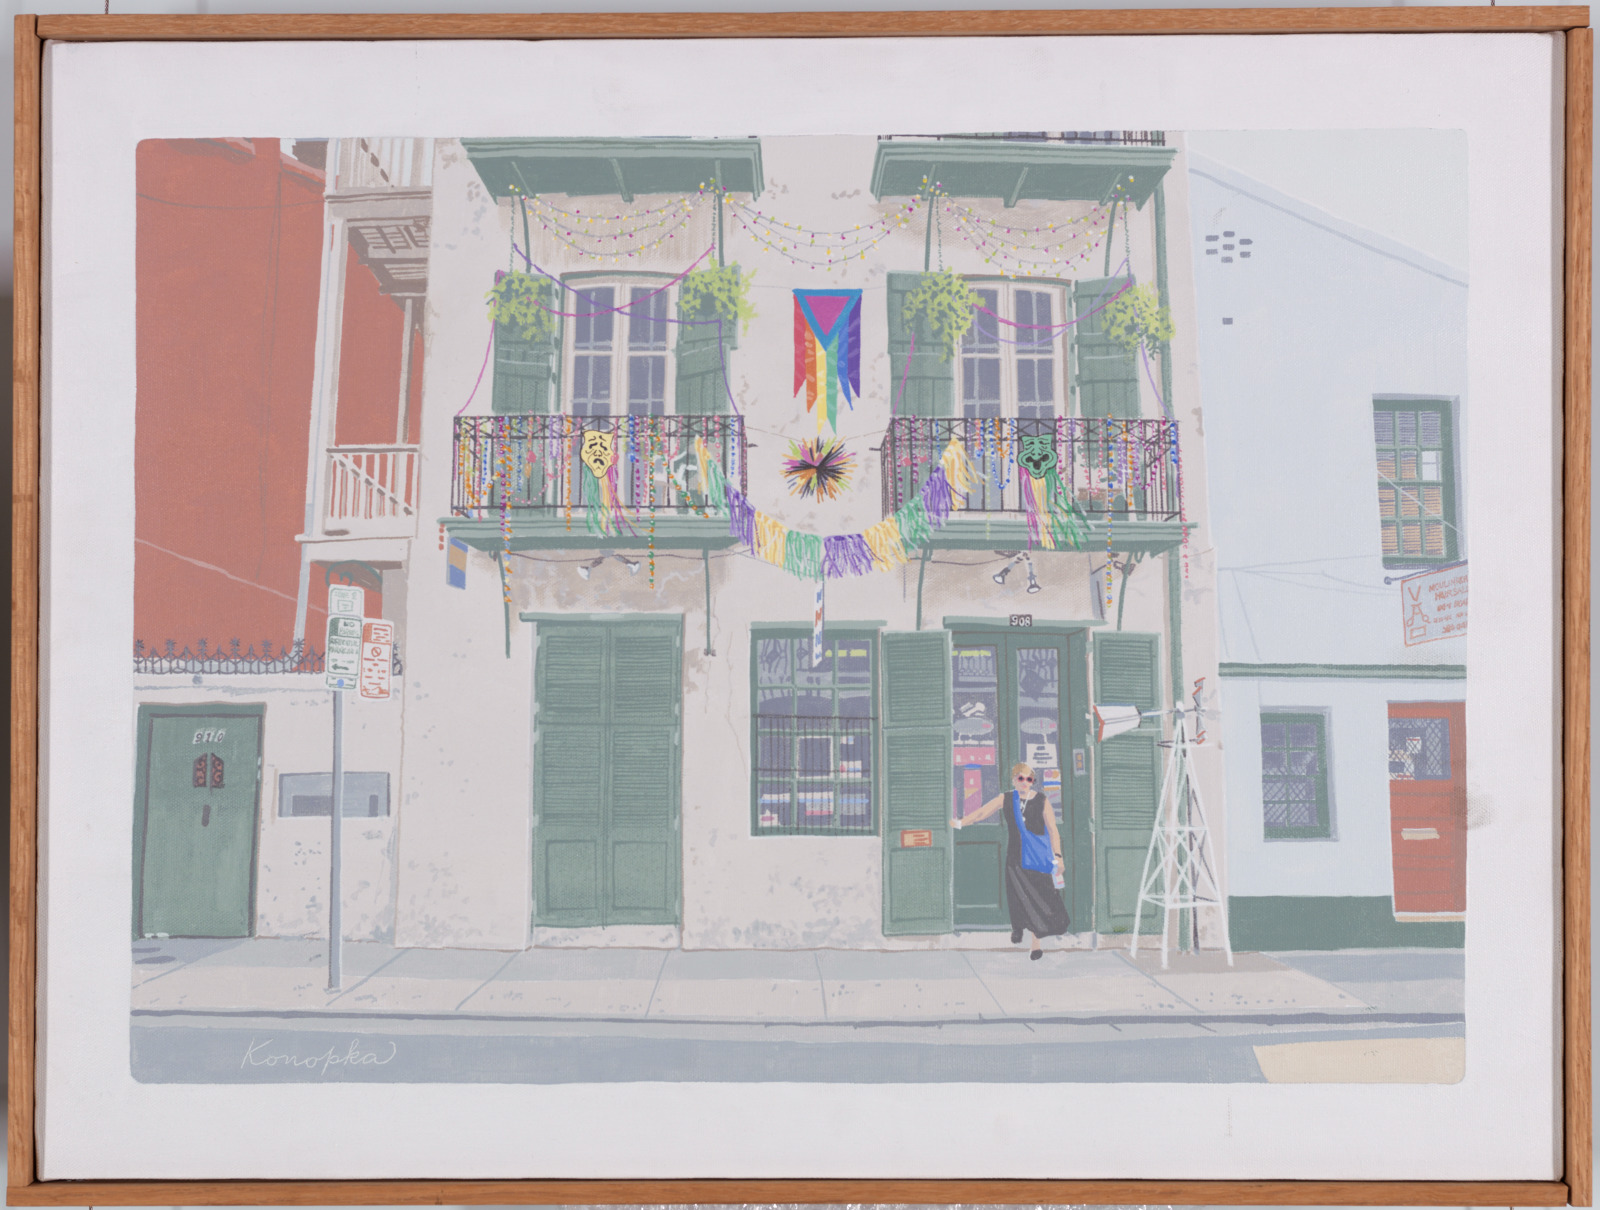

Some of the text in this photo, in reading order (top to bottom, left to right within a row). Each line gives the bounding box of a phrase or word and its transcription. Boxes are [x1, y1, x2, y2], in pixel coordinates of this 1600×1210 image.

[1010, 615, 1031, 627] 908
[194, 730, 225, 744] 910
[240, 1037, 397, 1076] Konopka
